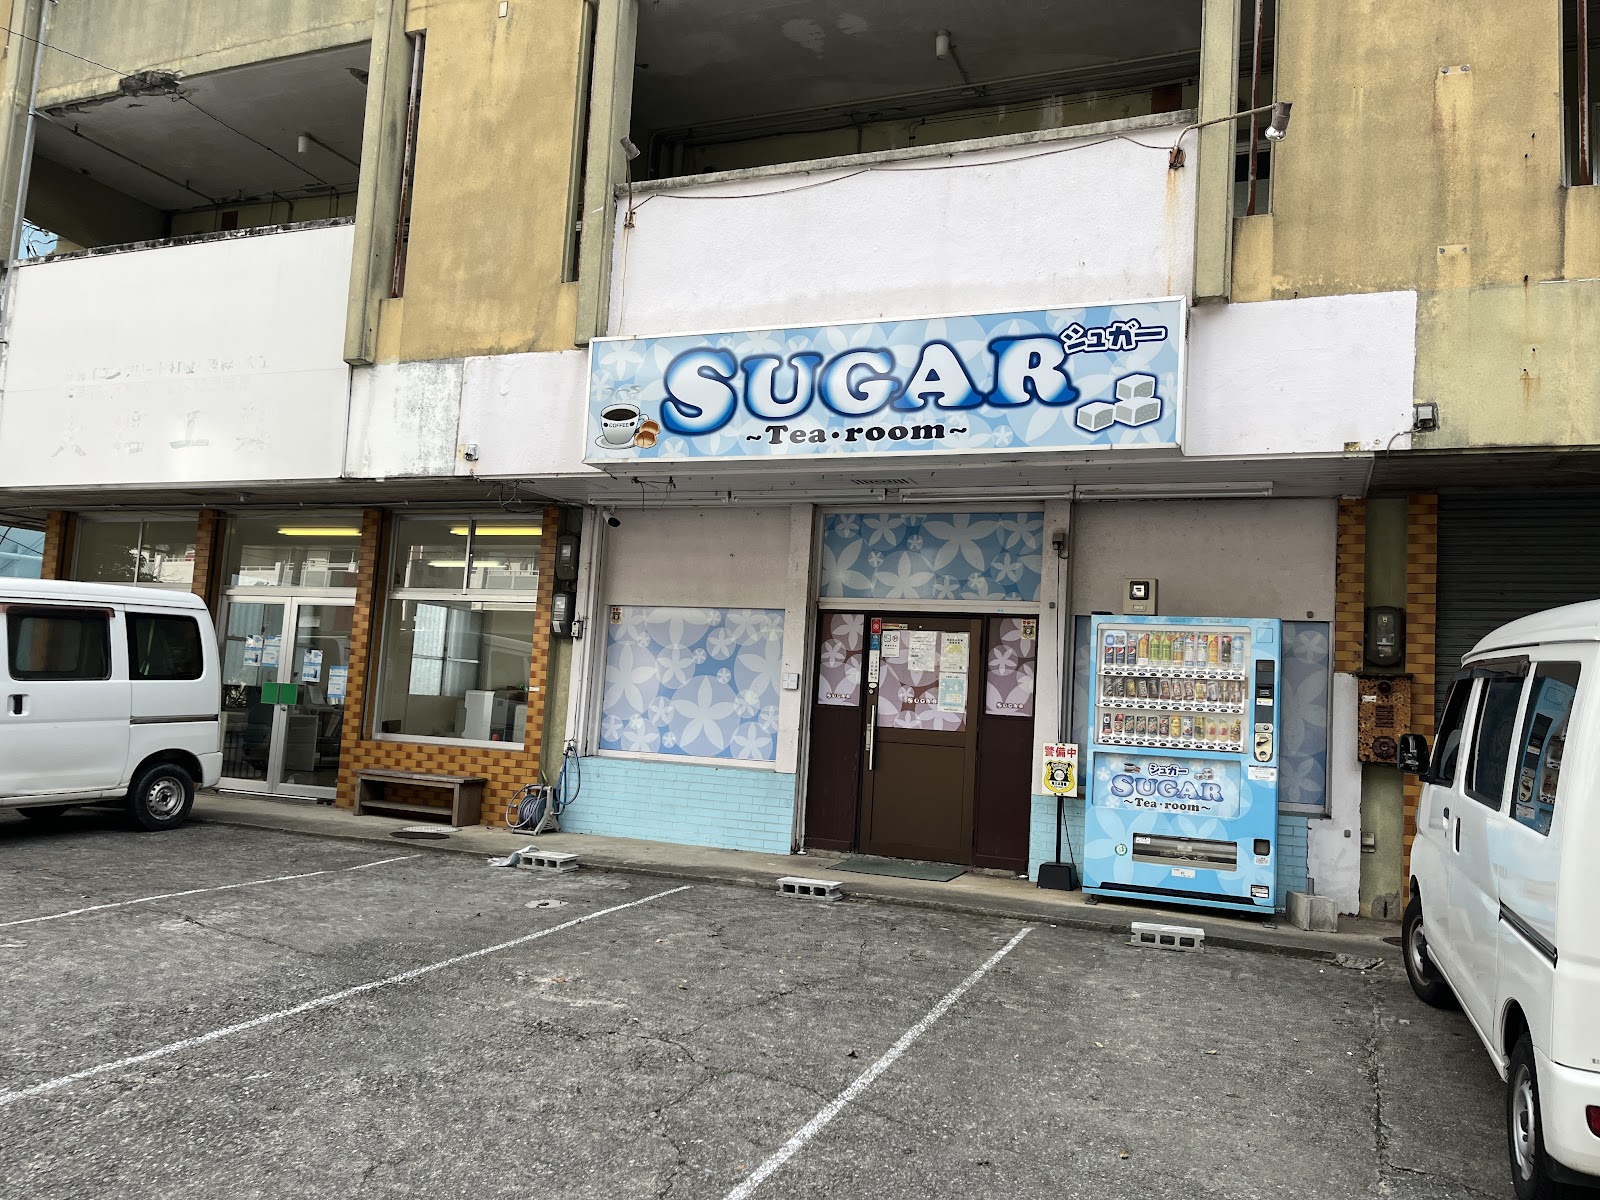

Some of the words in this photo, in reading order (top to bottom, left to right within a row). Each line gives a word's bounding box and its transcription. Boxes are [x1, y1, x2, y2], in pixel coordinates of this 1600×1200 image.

[1060, 318, 1168, 355] シュガー
[660, 333, 1080, 437] SUGAR
[907, 697, 938, 705] SUGAR
[1044, 745, 1077, 759] 警備中
[1148, 762, 1189, 777] シュガー
[1111, 774, 1224, 802] SUGAR
